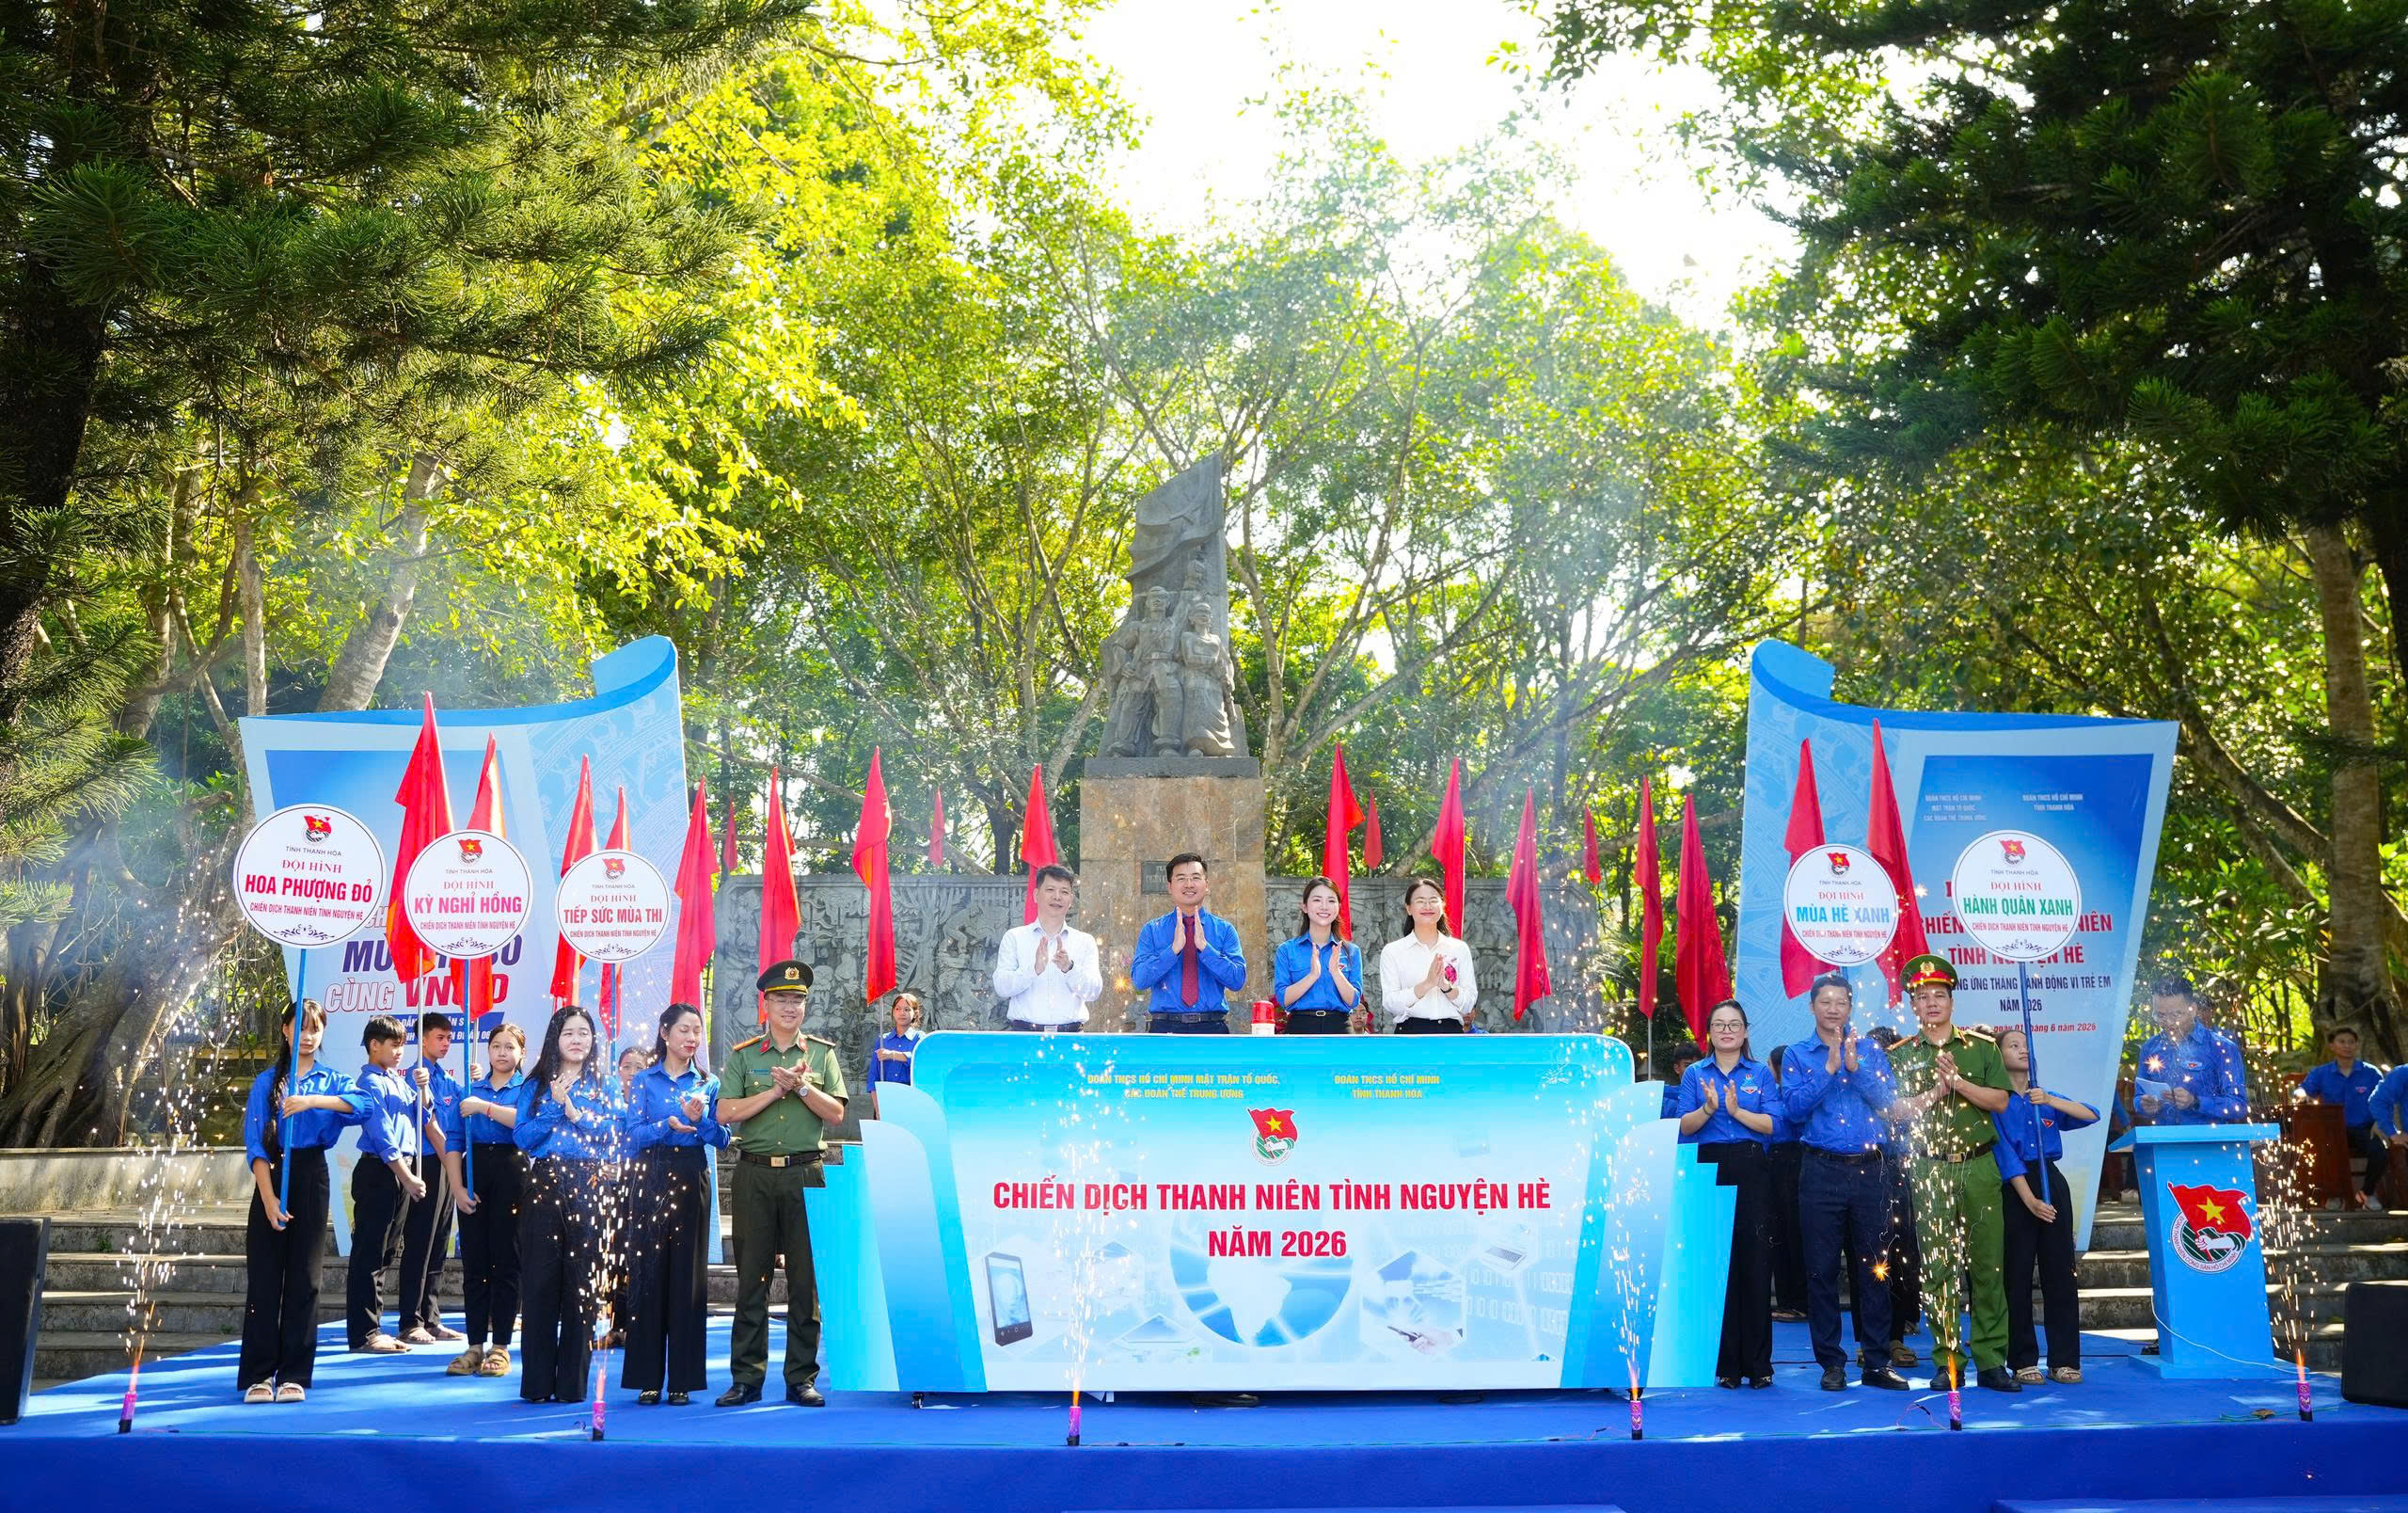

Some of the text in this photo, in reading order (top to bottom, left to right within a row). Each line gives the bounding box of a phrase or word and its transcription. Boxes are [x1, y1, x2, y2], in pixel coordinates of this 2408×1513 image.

[245, 874, 372, 902] HOA PHƯỢNG ĐỎ
[284, 905, 302, 915] THANH
[415, 891, 522, 914] KỲ NGHỈ HỒNG
[1797, 903, 1889, 923] MÙA HÈ XANH
[1963, 894, 2073, 916] HÀNH QUÂN XANH
[564, 904, 662, 923] TIẾP SỨC MÙA THI
[1921, 911, 1964, 933] HIẾN
[1948, 944, 1987, 964] TÌNH
[2064, 943, 2084, 964] HÈ
[1971, 975, 1988, 990] ỨNG
[1989, 976, 2018, 990] THÁNG
[2045, 975, 2068, 993] ĐỘNG
[2070, 975, 2079, 988] VÌ
[2081, 972, 2096, 988] TRẺ
[2099, 976, 2111, 988] EM
[325, 977, 395, 1012] CÙNG
[2023, 998, 2042, 1011] 026
[2077, 1023, 2096, 1031] 2026
[993, 1174, 1551, 1216] CHIẾN DỊCH THANH NIÊN TÌNH NGUYỆN HÈ
[1209, 1225, 1347, 1257] NĂM 2026
